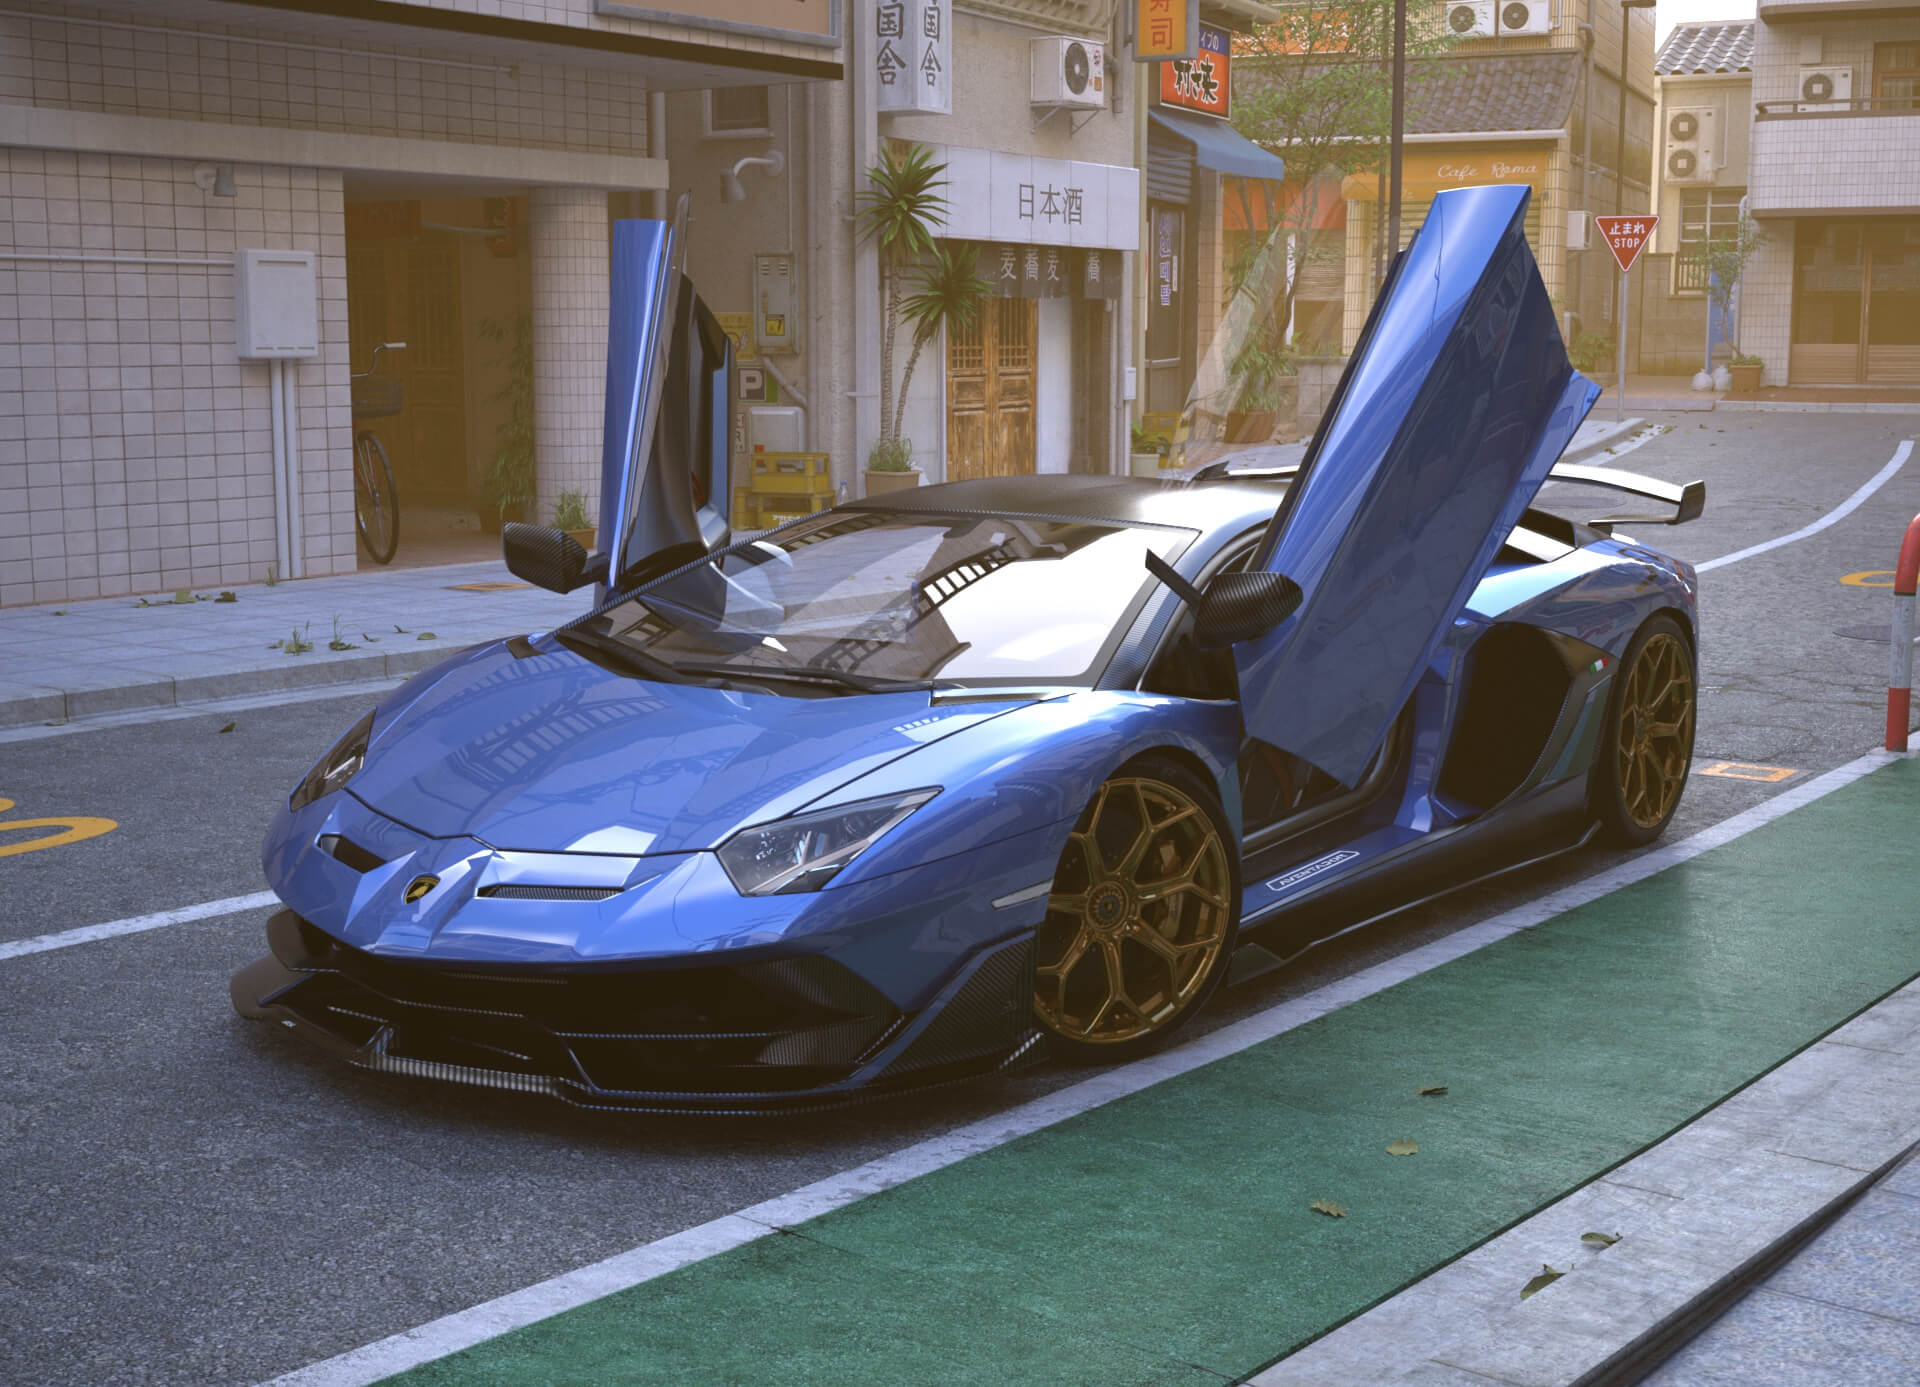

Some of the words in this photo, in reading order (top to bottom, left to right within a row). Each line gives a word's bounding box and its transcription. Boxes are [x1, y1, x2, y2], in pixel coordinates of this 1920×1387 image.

[877, 0, 906, 86] 国舎
[920, 0, 941, 87] 国舎
[1437, 164, 1479, 183] Cafe
[1018, 183, 1084, 225] 日本酒
[1609, 221, 1646, 235] 止まれ
[1614, 238, 1640, 249] STOP
[740, 369, 763, 399] P
